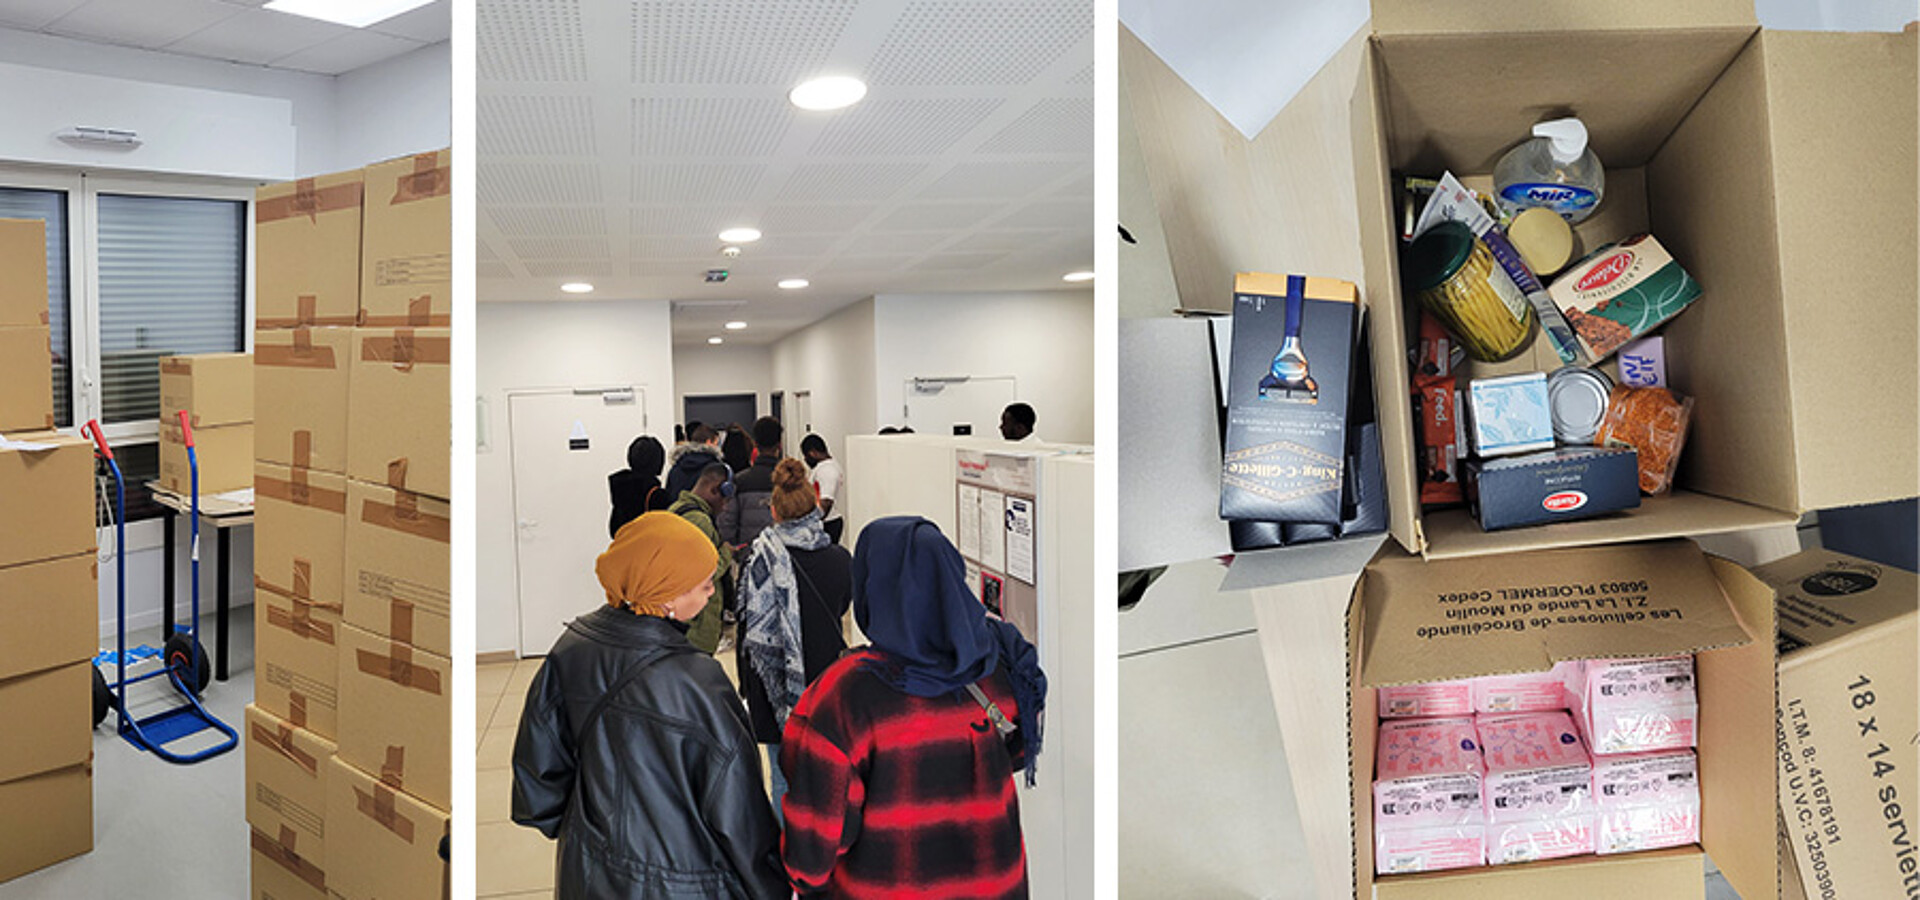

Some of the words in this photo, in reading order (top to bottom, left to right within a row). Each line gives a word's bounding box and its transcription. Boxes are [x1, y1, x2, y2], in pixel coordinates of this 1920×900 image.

[1497, 584, 1597, 598] PLOERMEL
[1600, 580, 1649, 594] 56803
[1437, 590, 1492, 604] Cedex
[1596, 597, 1618, 610] La
[1445, 604, 1506, 619] Moulin
[1511, 602, 1534, 615] du
[1538, 599, 1592, 612] Lande
[1557, 610, 1645, 625] celluloses
[1650, 608, 1683, 620] Les
[1416, 619, 1526, 639] Brocéliande
[1530, 617, 1552, 630] de
[1848, 675, 1876, 709] 18
[1858, 716, 1878, 736] x
[1867, 743, 1895, 778] 14
[1809, 768, 1842, 846] 41678191
[1878, 785, 1919, 900] serviett
